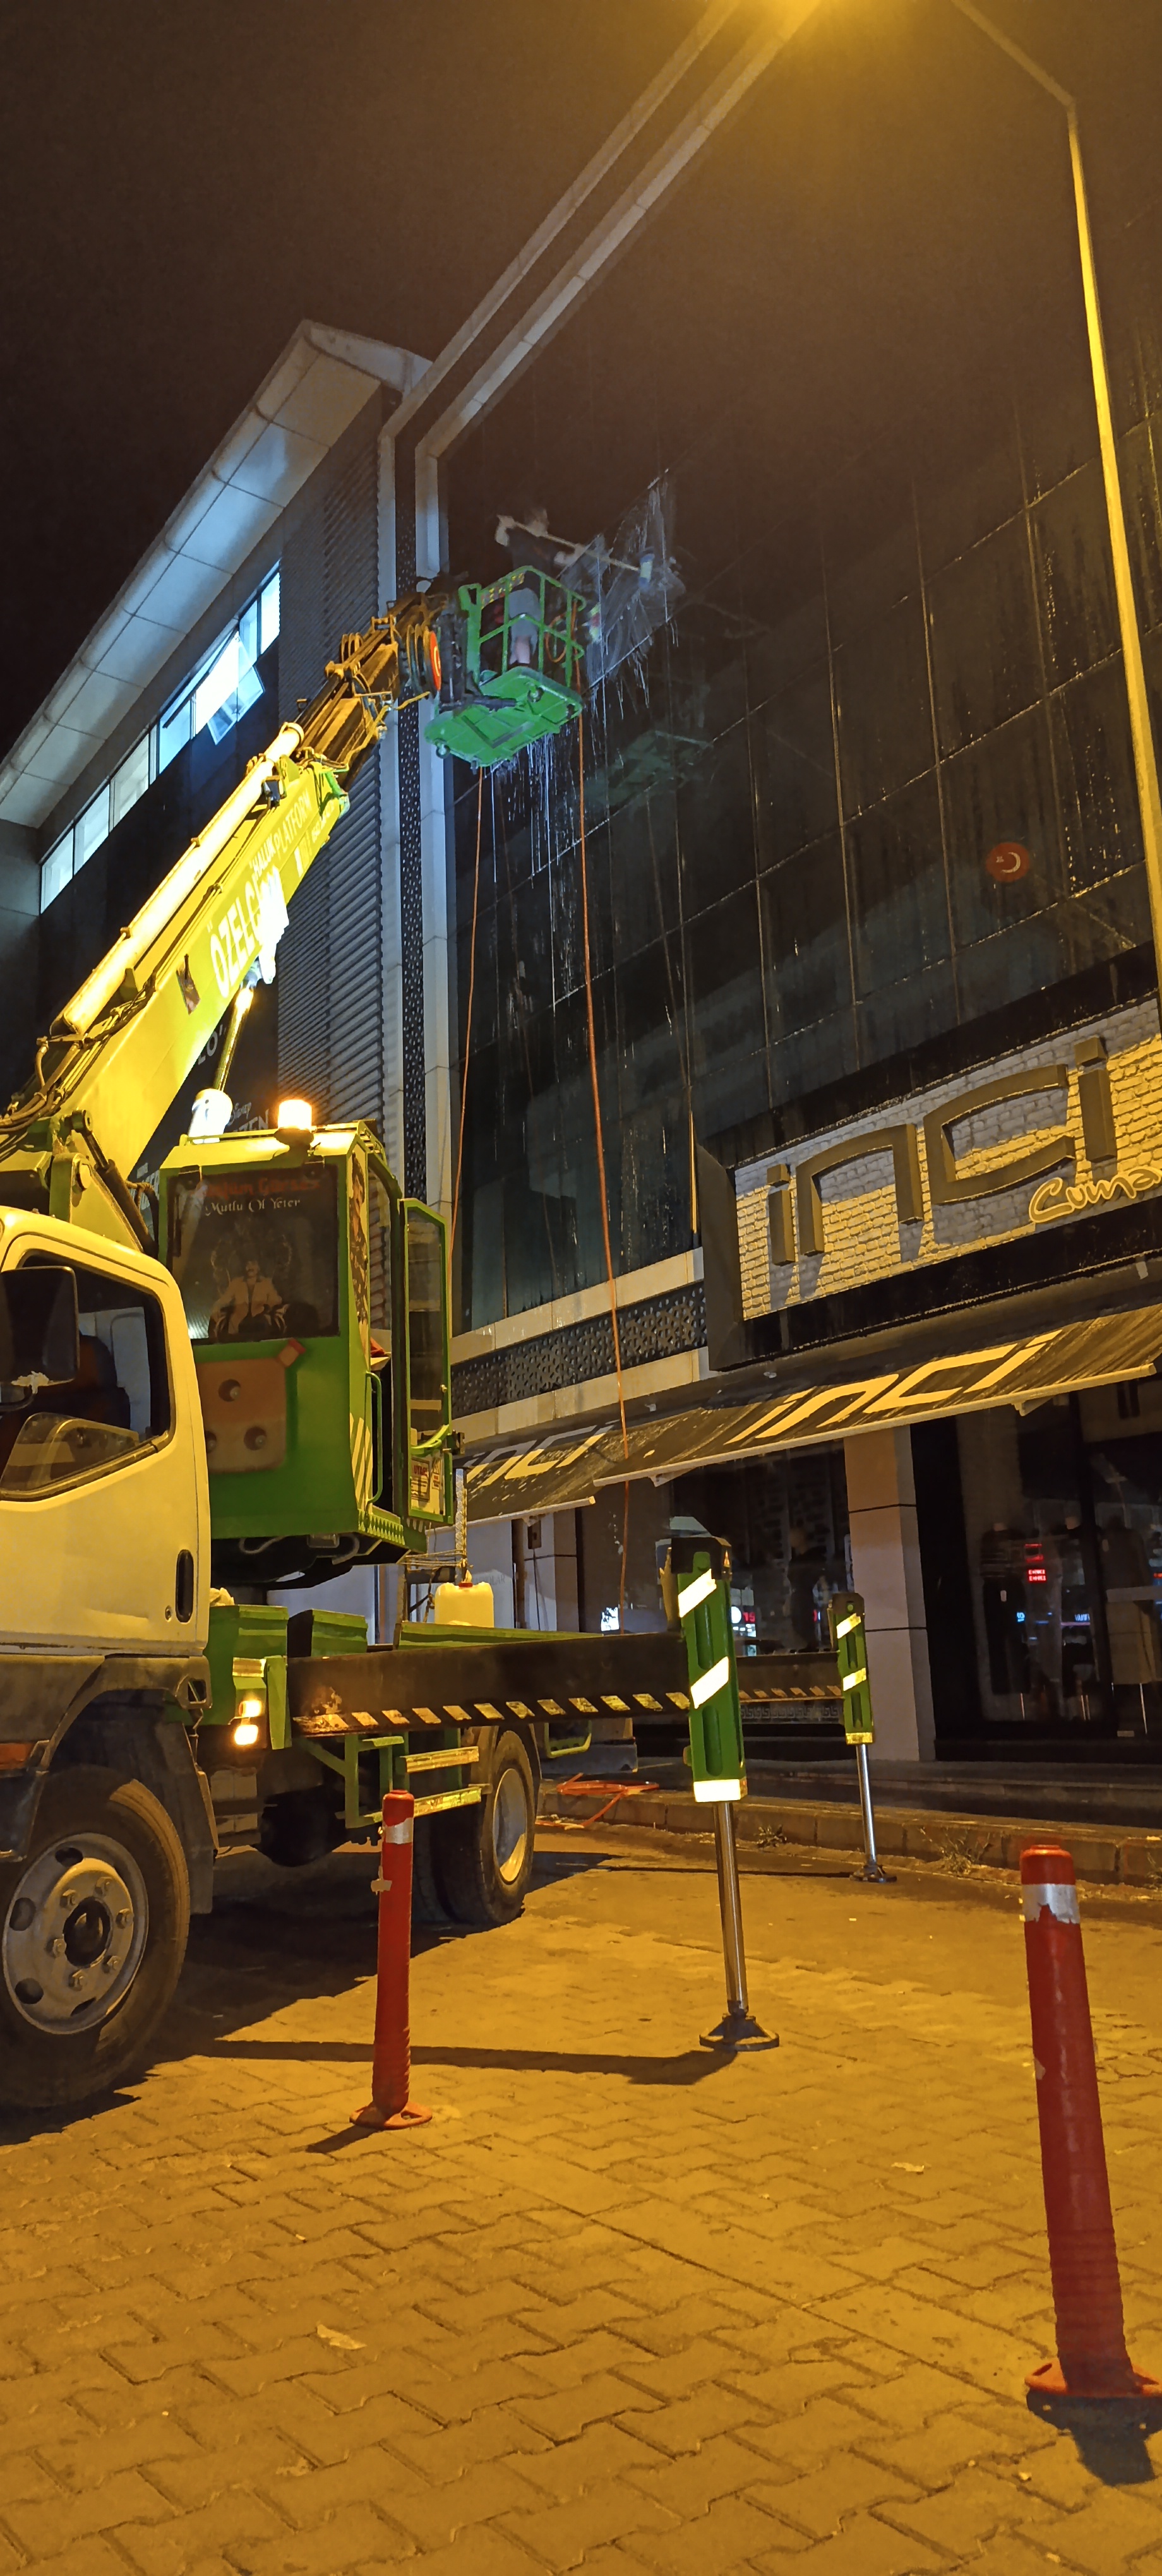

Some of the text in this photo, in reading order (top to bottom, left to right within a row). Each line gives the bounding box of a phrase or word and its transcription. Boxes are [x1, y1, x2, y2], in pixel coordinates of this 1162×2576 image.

[272, 791, 313, 860] PLATFORM
[767, 1036, 1117, 1265] inci
[205, 1197, 301, 1216] Mutlu Ol Yeter
[723, 1329, 1062, 1445] inci
